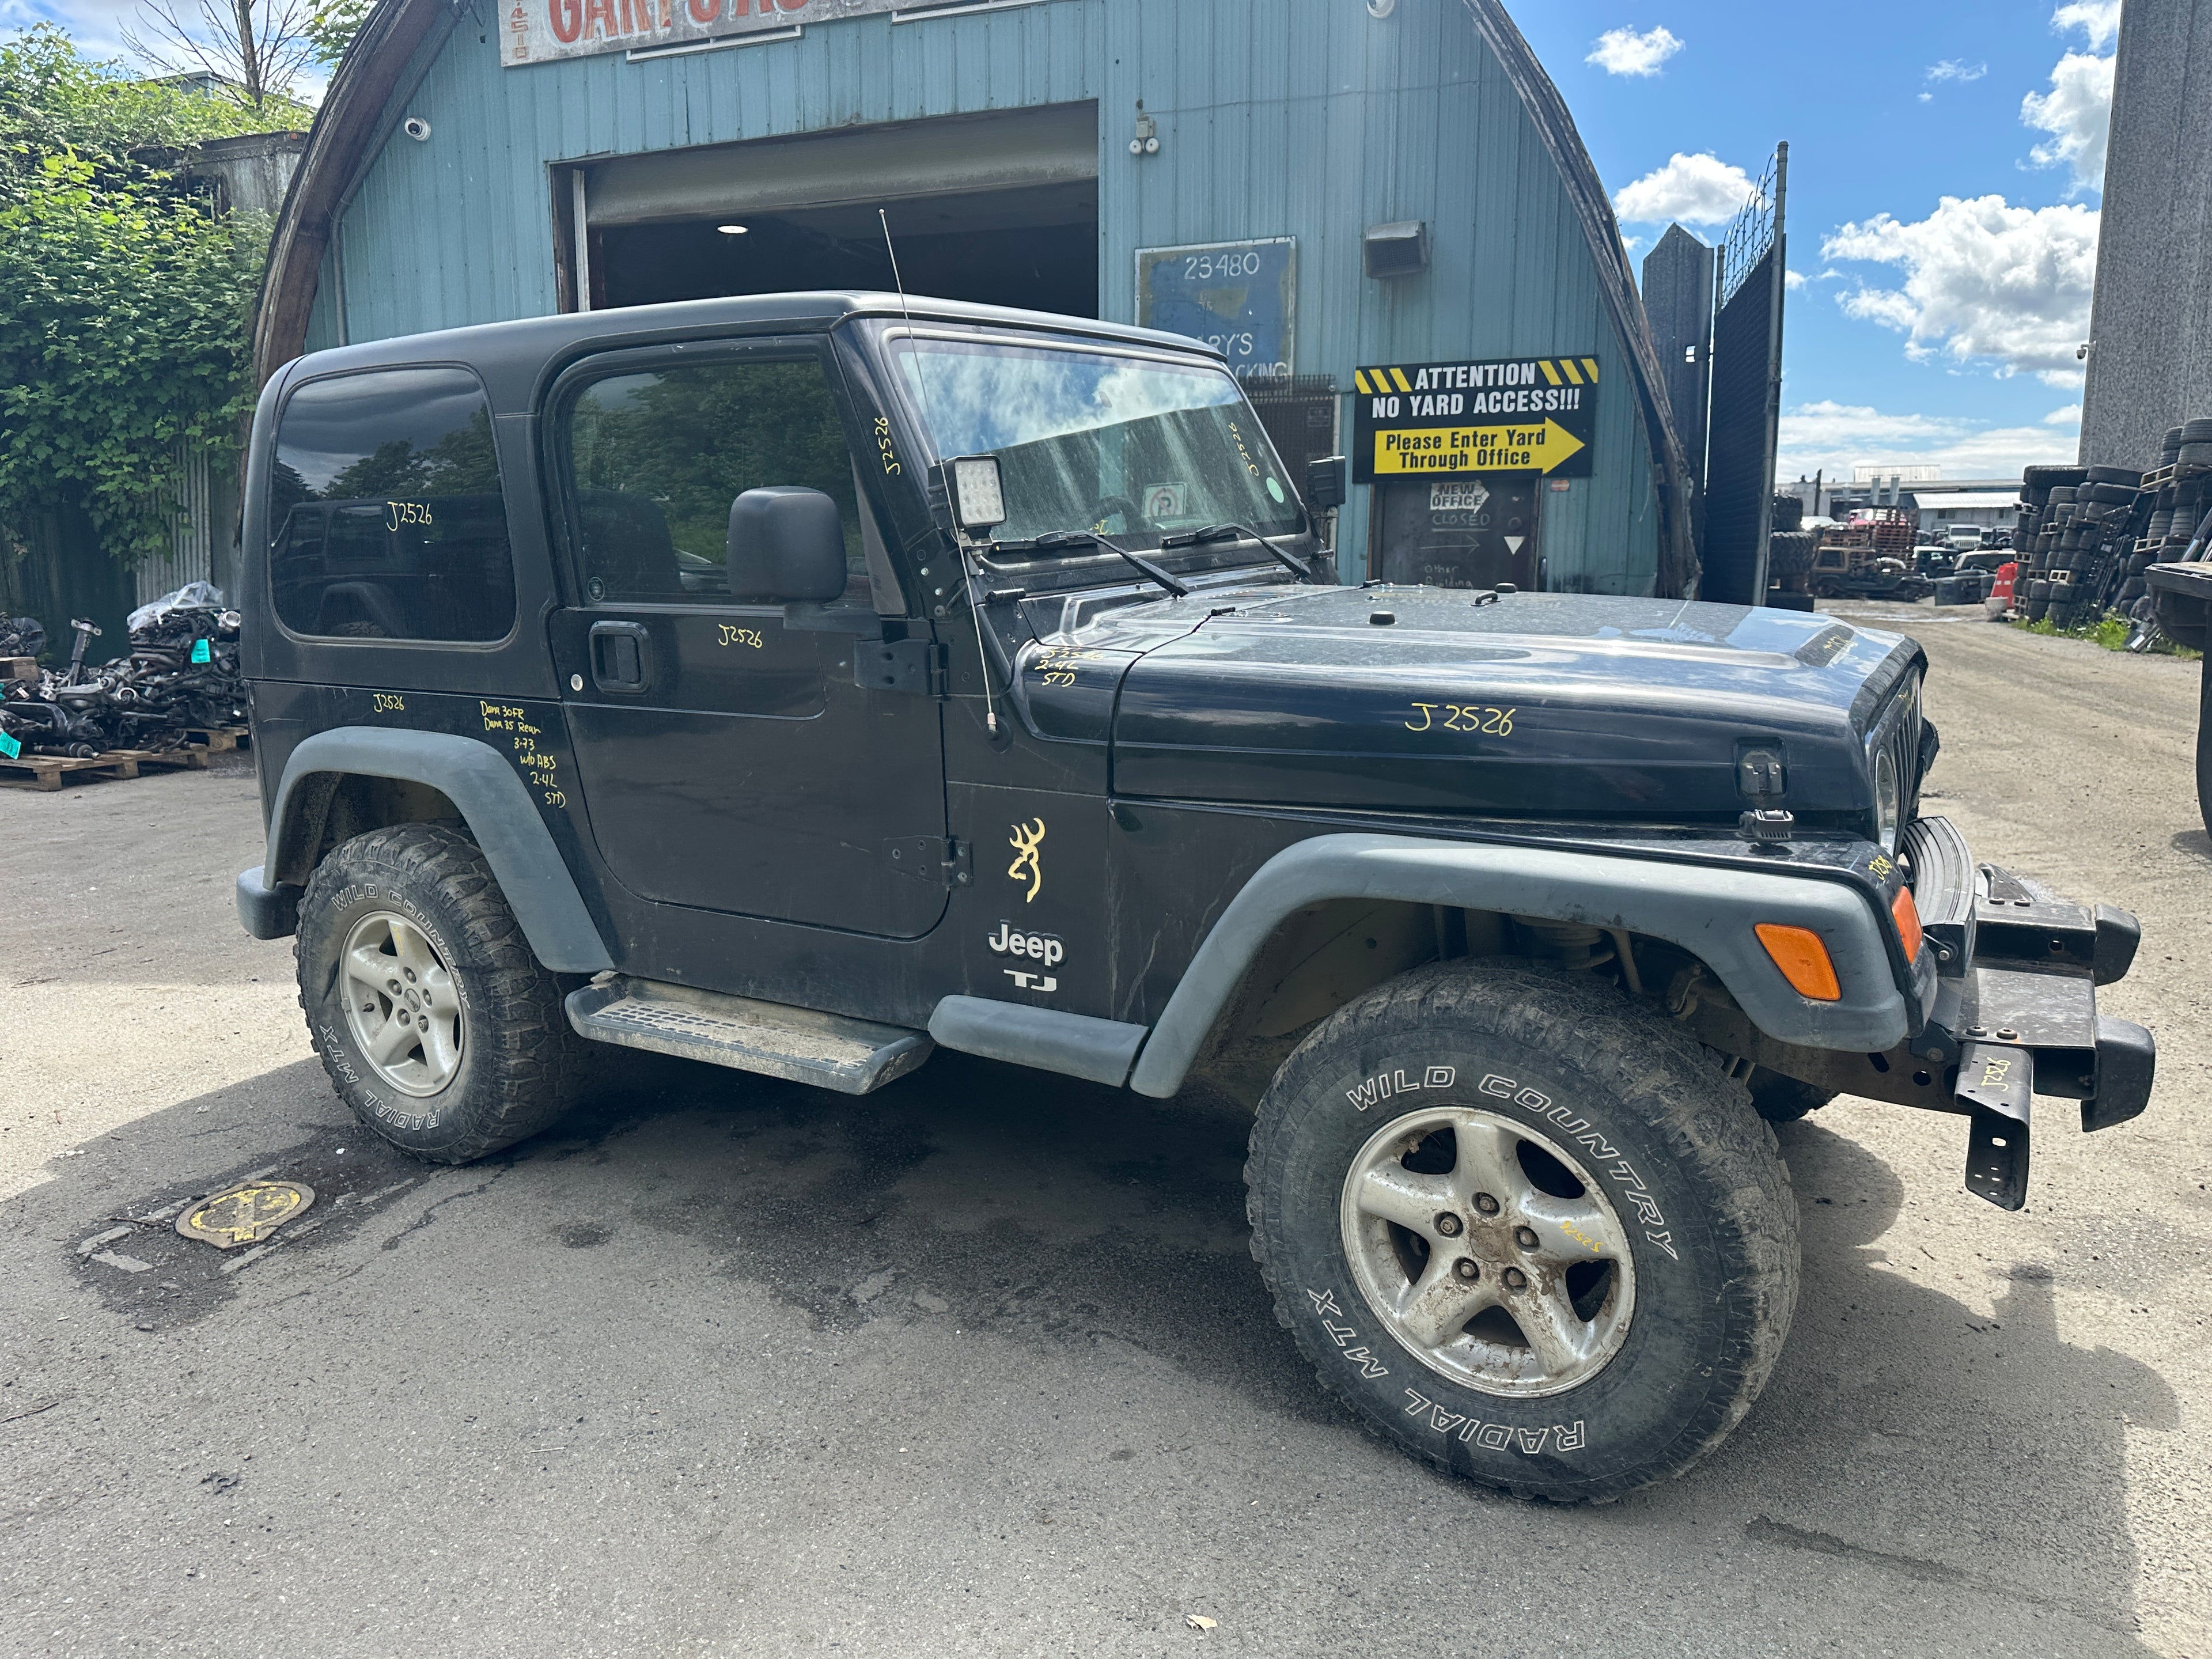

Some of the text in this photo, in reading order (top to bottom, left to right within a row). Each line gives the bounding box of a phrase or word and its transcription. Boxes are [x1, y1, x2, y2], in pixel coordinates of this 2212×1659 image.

[1184, 252, 1260, 281] 23480
[1197, 332, 1253, 356] RY'S
[1414, 363, 1536, 391] ATTENTION
[1372, 388, 1580, 418] NO YARD ACCESS!!!
[874, 416, 902, 475] J2526
[1228, 422, 1260, 477] J2526
[1386, 428, 1546, 450] Please Enter Yard
[1399, 448, 1531, 470] Through Office
[1432, 495, 1483, 507] OFFICE
[1438, 483, 1476, 495] NEW
[387, 500, 433, 532] J2526
[1433, 514, 1490, 527] CLOSED
[718, 623, 763, 649] J2526
[1041, 672, 1075, 688] STD
[373, 693, 404, 713] J2526
[504, 719, 514, 730] 35
[517, 722, 541, 734] Rear
[537, 753, 556, 770] ABS
[529, 771, 558, 788] 2.4L
[544, 791, 566, 809] STD
[331, 883, 379, 911] WILD
[388, 889, 471, 1010] COUNTRY
[988, 923, 1064, 967] Jeep
[1003, 968, 1058, 993] TJ
[319, 1024, 441, 1131] RADIAL MTX
[1346, 1065, 1679, 1261] WILD COUNTRY
[1306, 1287, 1587, 1456] RADIAL MTX
